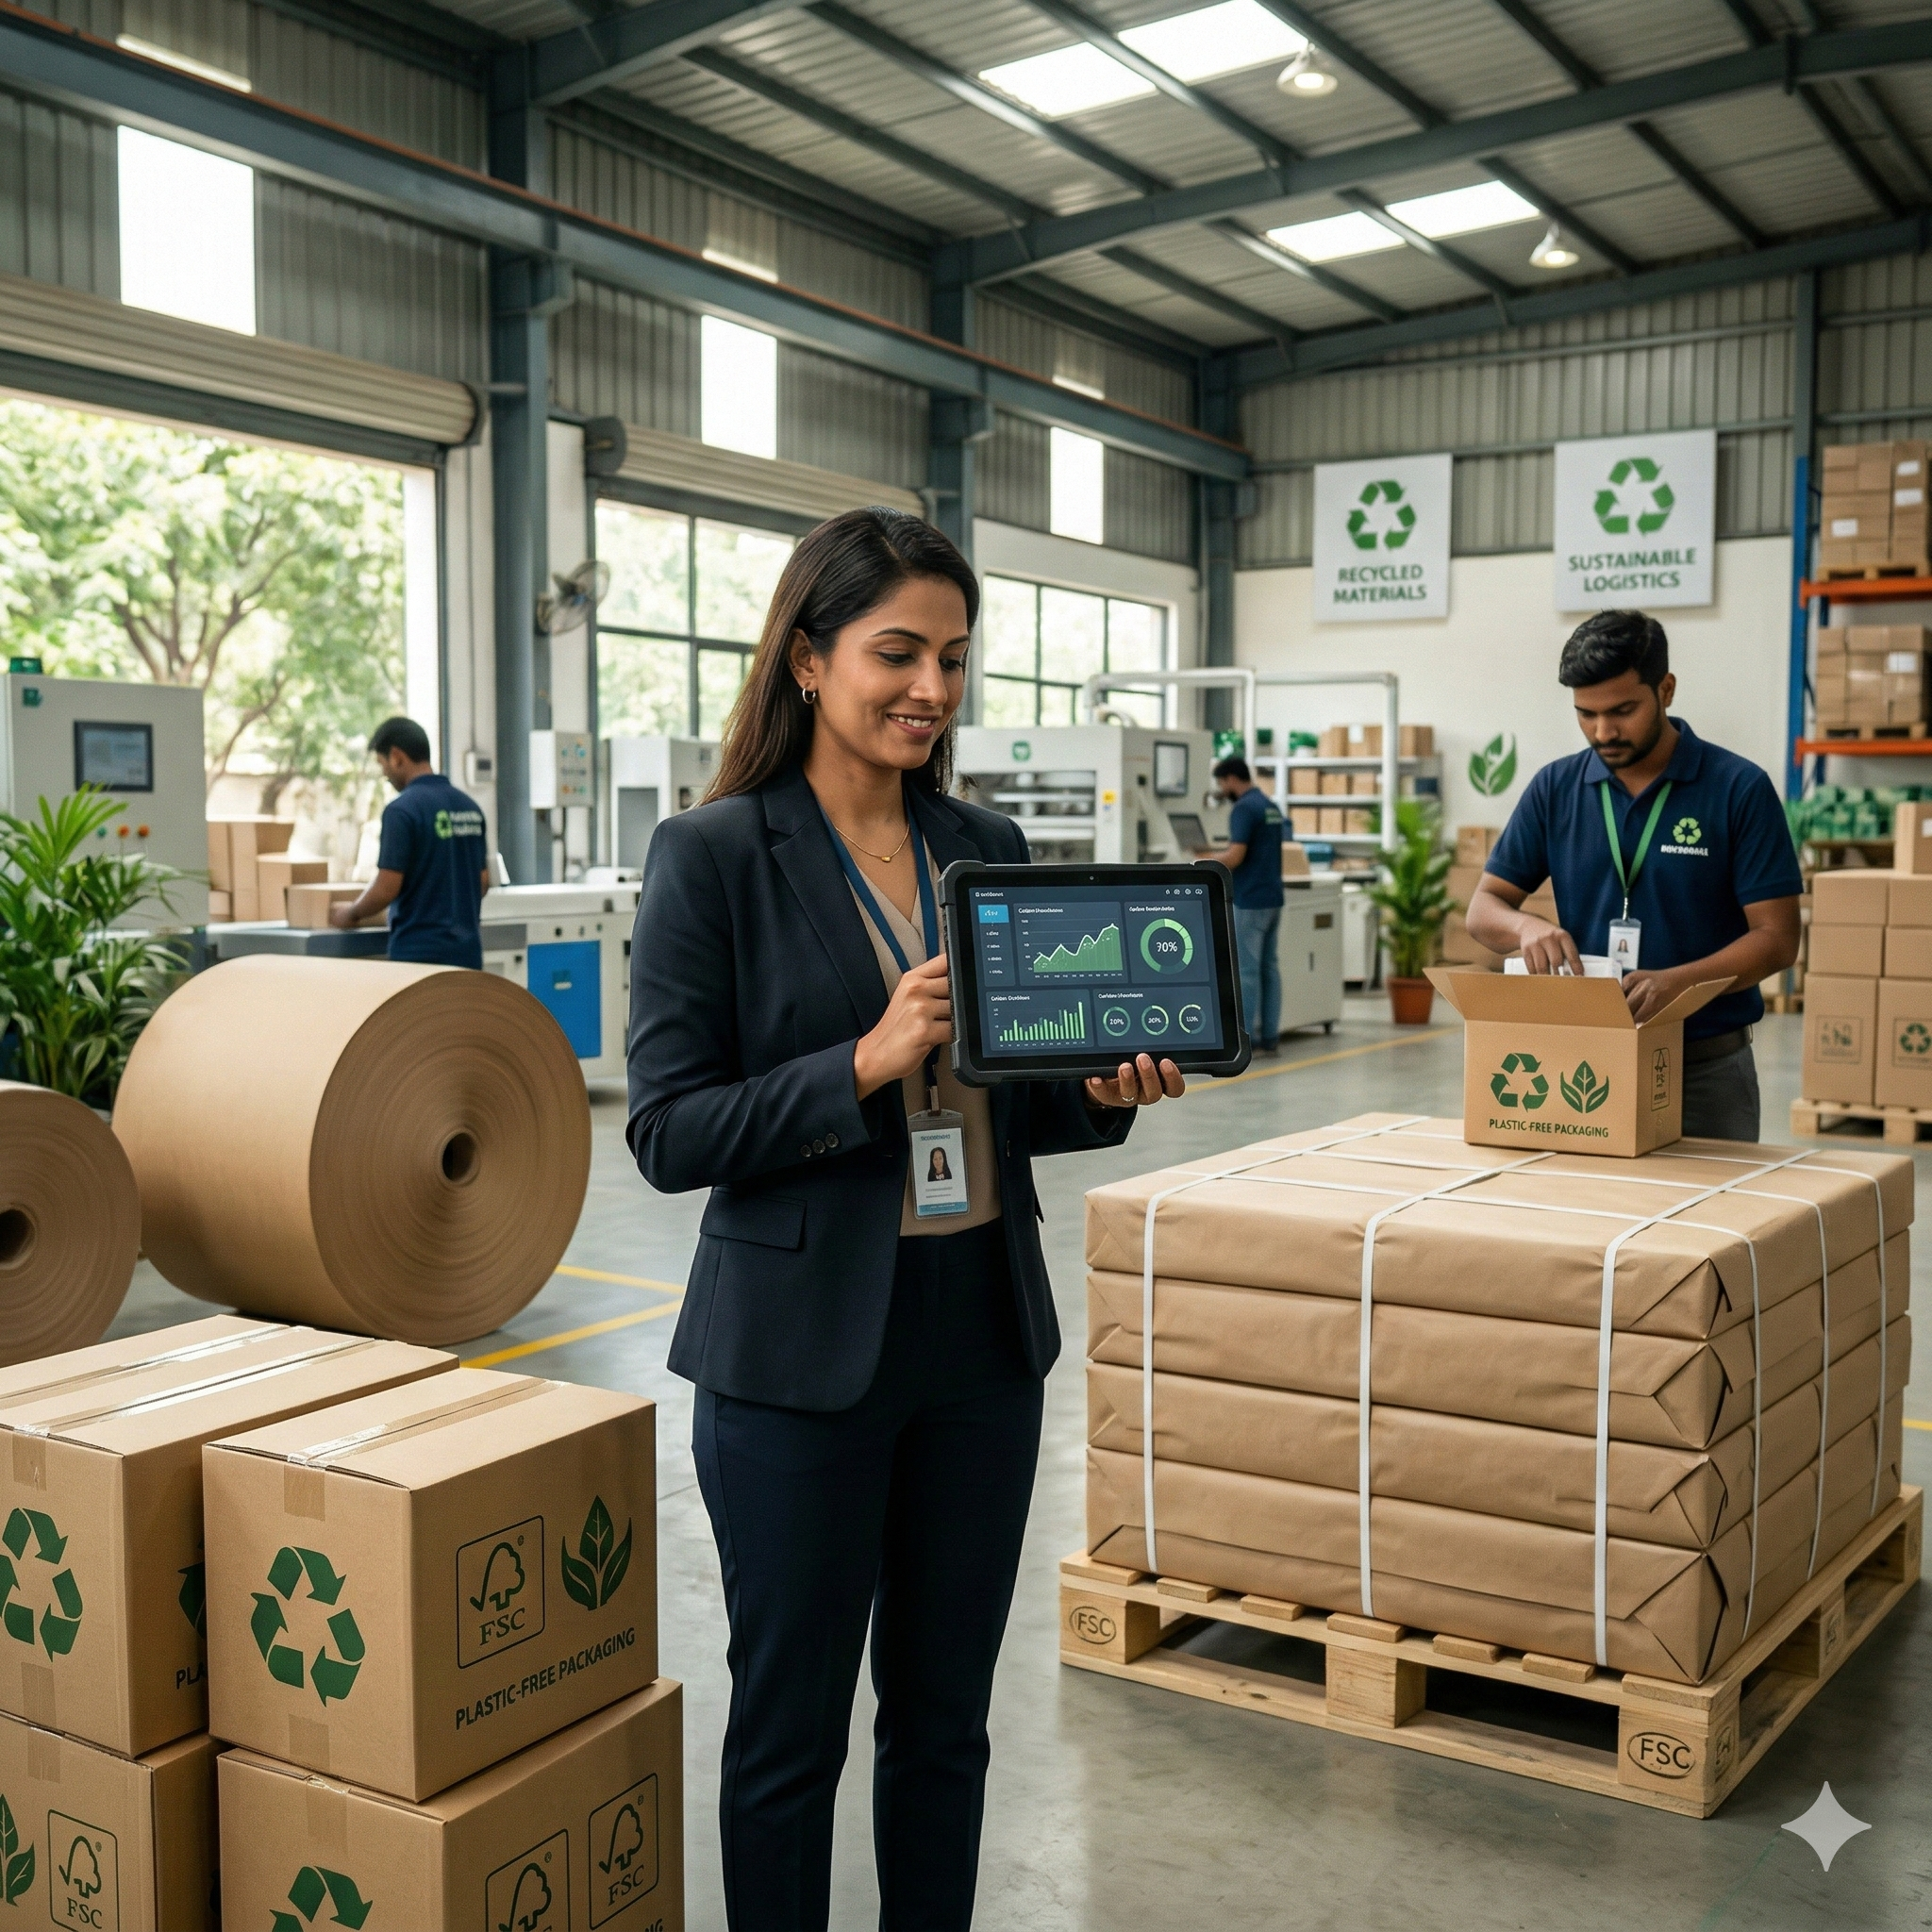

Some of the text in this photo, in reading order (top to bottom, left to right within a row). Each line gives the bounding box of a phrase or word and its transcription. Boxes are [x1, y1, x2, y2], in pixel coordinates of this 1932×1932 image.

[1568, 547, 1696, 572] SUSTAINABLE
[1338, 564, 1424, 582] RECYCLED
[1583, 571, 1680, 592] LOGISTICS
[1333, 584, 1426, 603] MATERIALS
[1489, 1118, 1609, 1138] PLASTIC-FREE PACKAGING
[479, 1607, 525, 1646] FSC
[1077, 1612, 1111, 1637] FSC
[457, 1627, 636, 1730] PLASTIC-FREE PACKAGING
[1640, 1738, 1691, 1771] FSC
[608, 1864, 644, 1907] FSC
[67, 1896, 103, 1930] FSC
